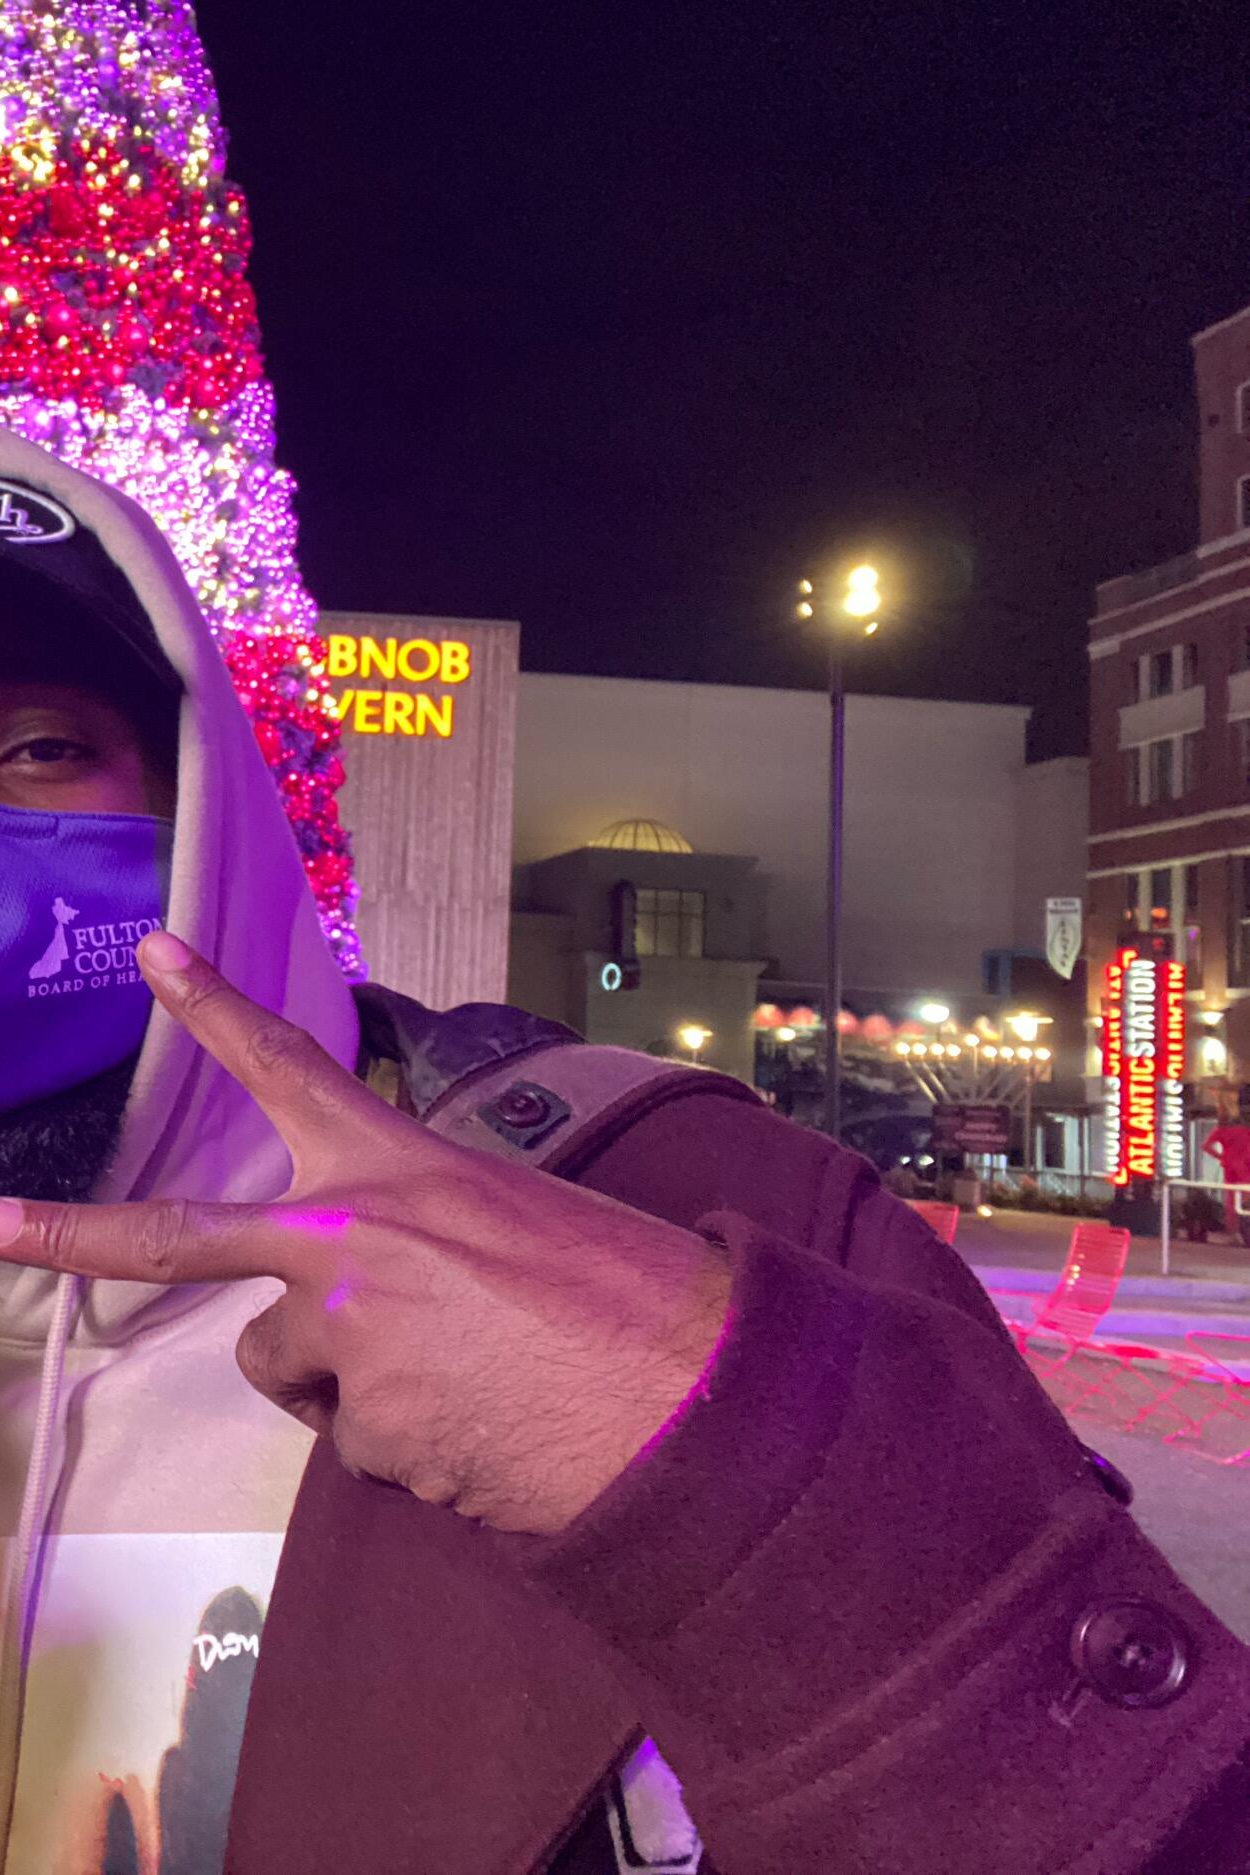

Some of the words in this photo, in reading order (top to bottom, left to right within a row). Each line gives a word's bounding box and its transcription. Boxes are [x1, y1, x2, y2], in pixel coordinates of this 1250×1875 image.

[28, 980, 85, 998] BOARD
[90, 976, 111, 989] OF
[1126, 959, 1156, 1058] STATION
[1128, 1057, 1156, 1176] ATLANTIC
